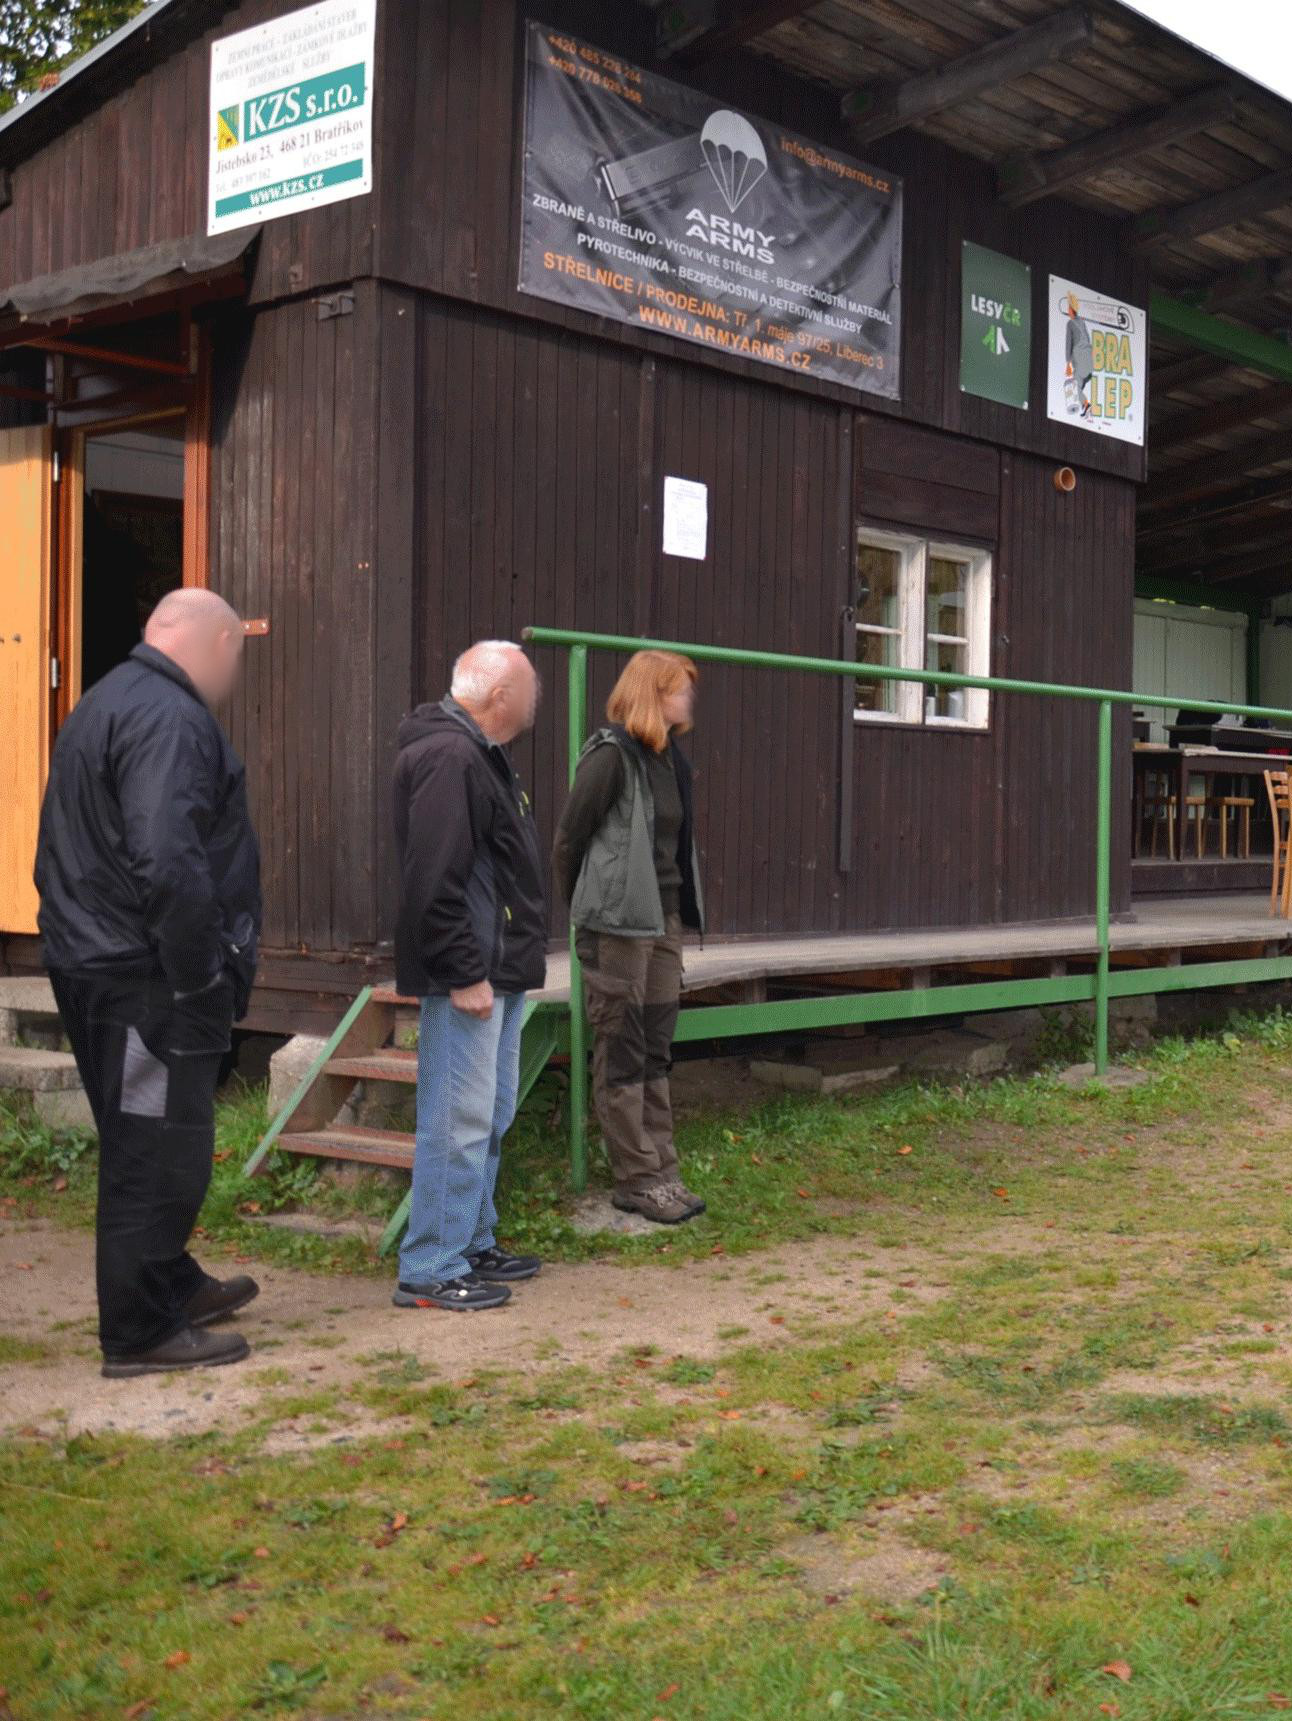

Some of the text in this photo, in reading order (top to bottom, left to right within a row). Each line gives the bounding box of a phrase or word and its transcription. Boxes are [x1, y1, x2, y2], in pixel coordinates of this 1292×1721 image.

[250, 84, 358, 136] KZS s.r.o.
[280, 138, 297, 153] 468
[300, 133, 311, 150] 21
[315, 119, 364, 143] Bratříkov
[781, 136, 891, 193] info@armyarms.cz
[250, 172, 324, 206] www.kzs.cz
[686, 208, 776, 248] ARMY
[686, 224, 775, 265] ARMS
[533, 193, 585, 222] ZBRANĚ
[587, 212, 596, 226] A
[599, 215, 656, 245] STŘELIVO
[706, 253, 720, 268] VE
[723, 257, 768, 283] STŘELBĚ
[848, 301, 893, 326] MATERIÁL
[577, 233, 669, 274] PYROTECHNIKA
[678, 265, 759, 301] BEZPEČNOSTNÍ
[760, 293, 768, 305] A
[769, 296, 823, 323] DETEKTIVNÍ
[824, 314, 862, 334] SLUŽBY
[543, 252, 634, 294] STŘELNICE
[646, 285, 731, 323] PRODEJNA:
[836, 342, 874, 367] Liberec
[876, 355, 884, 370] 3
[971, 294, 1021, 327] LESY ČR
[639, 305, 812, 370] WWW.ARMYARMS.CZ
[1091, 329, 1133, 376] BRA
[1090, 375, 1133, 420] LEP
